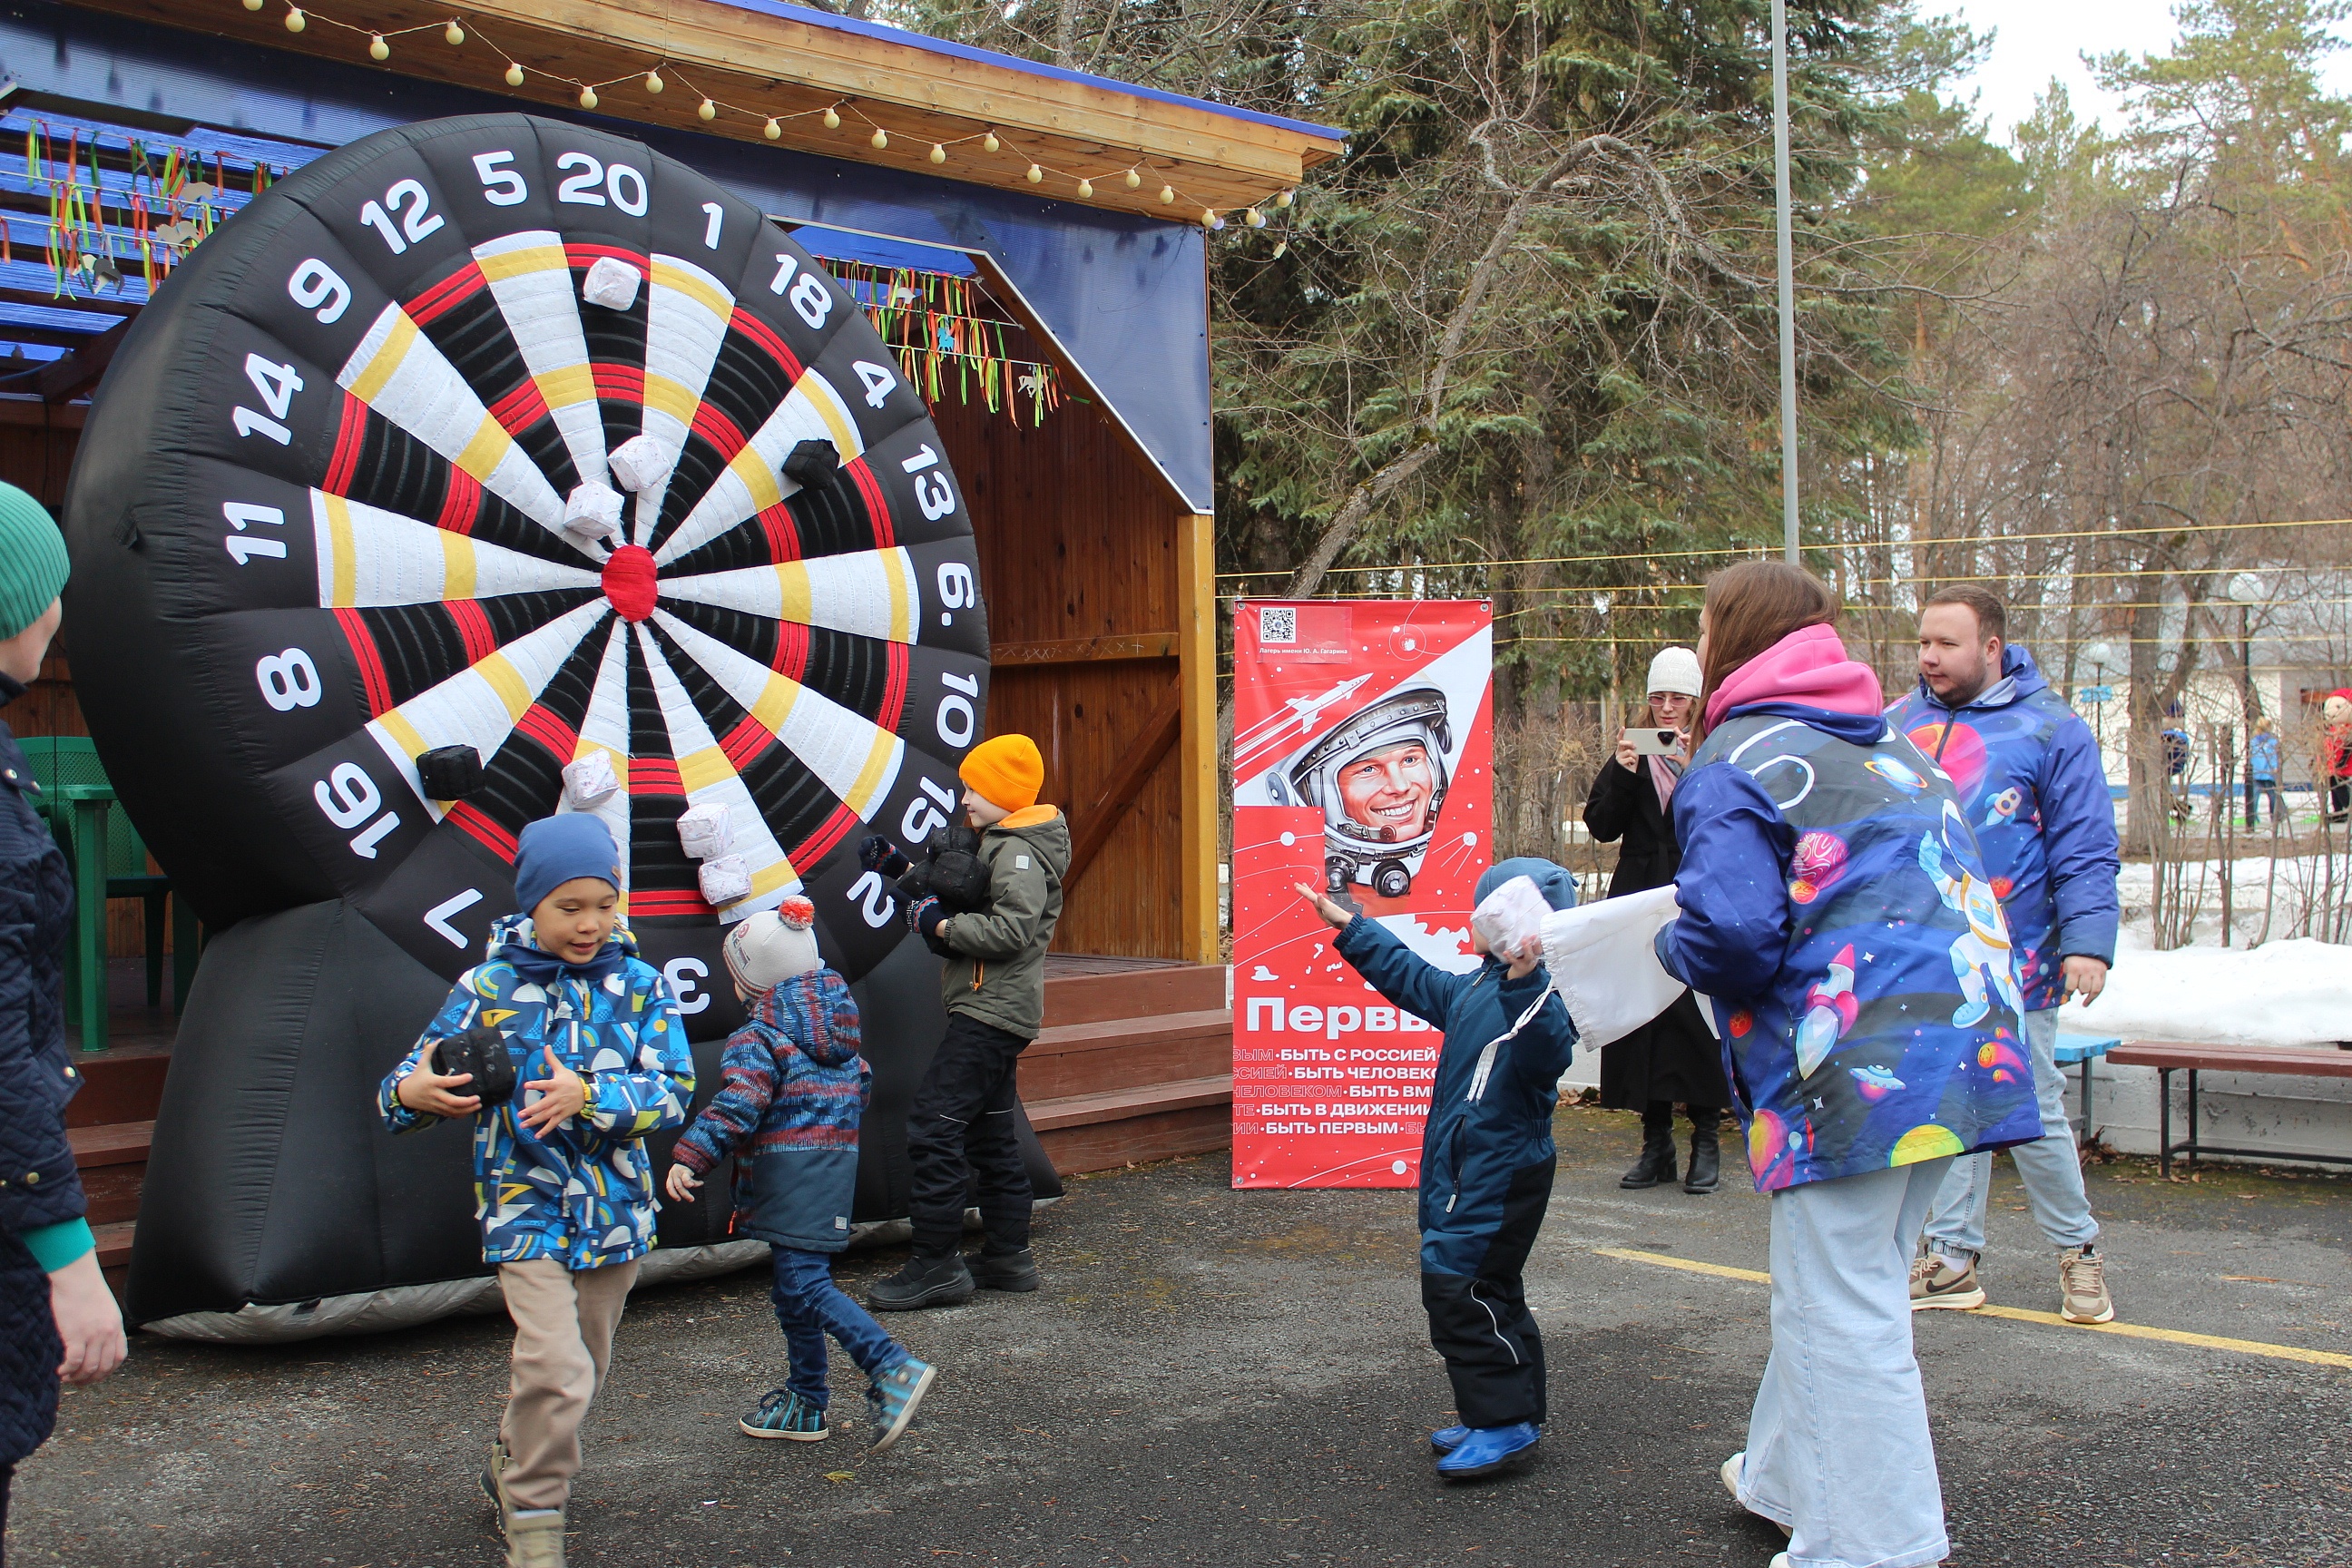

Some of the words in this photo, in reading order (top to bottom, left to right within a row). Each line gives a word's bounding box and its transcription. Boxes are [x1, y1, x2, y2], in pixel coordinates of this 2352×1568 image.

[472, 150, 527, 206] 5
[556, 152, 648, 217] 20
[360, 179, 445, 255] 12
[701, 201, 723, 250] 1
[288, 258, 351, 324] 9
[769, 253, 834, 330] 18
[232, 352, 304, 446] 14
[852, 360, 897, 409] 4
[901, 442, 956, 521] 13
[223, 501, 287, 565] 11
[256, 647, 322, 711] 8
[936, 671, 979, 749] 10
[314, 761, 400, 859] 16
[901, 776, 956, 853] 15
[423, 887, 484, 949] 7
[846, 870, 896, 928] 2
[663, 957, 710, 1014] 3
[1280, 1048, 1331, 1062] БЫТЬ
[1334, 1048, 1347, 1062] С
[1350, 1046, 1436, 1062] РОССИЕЙ
[1294, 1066, 1345, 1080] БЫТЬ
[1261, 1103, 1312, 1116] БЫТЬ
[1316, 1103, 1328, 1116] В
[1349, 1085, 1399, 1098] БЫТЬ
[1266, 1122, 1316, 1134] БЫТЬ
[1319, 1122, 1398, 1134] ПЕРВЫМ
